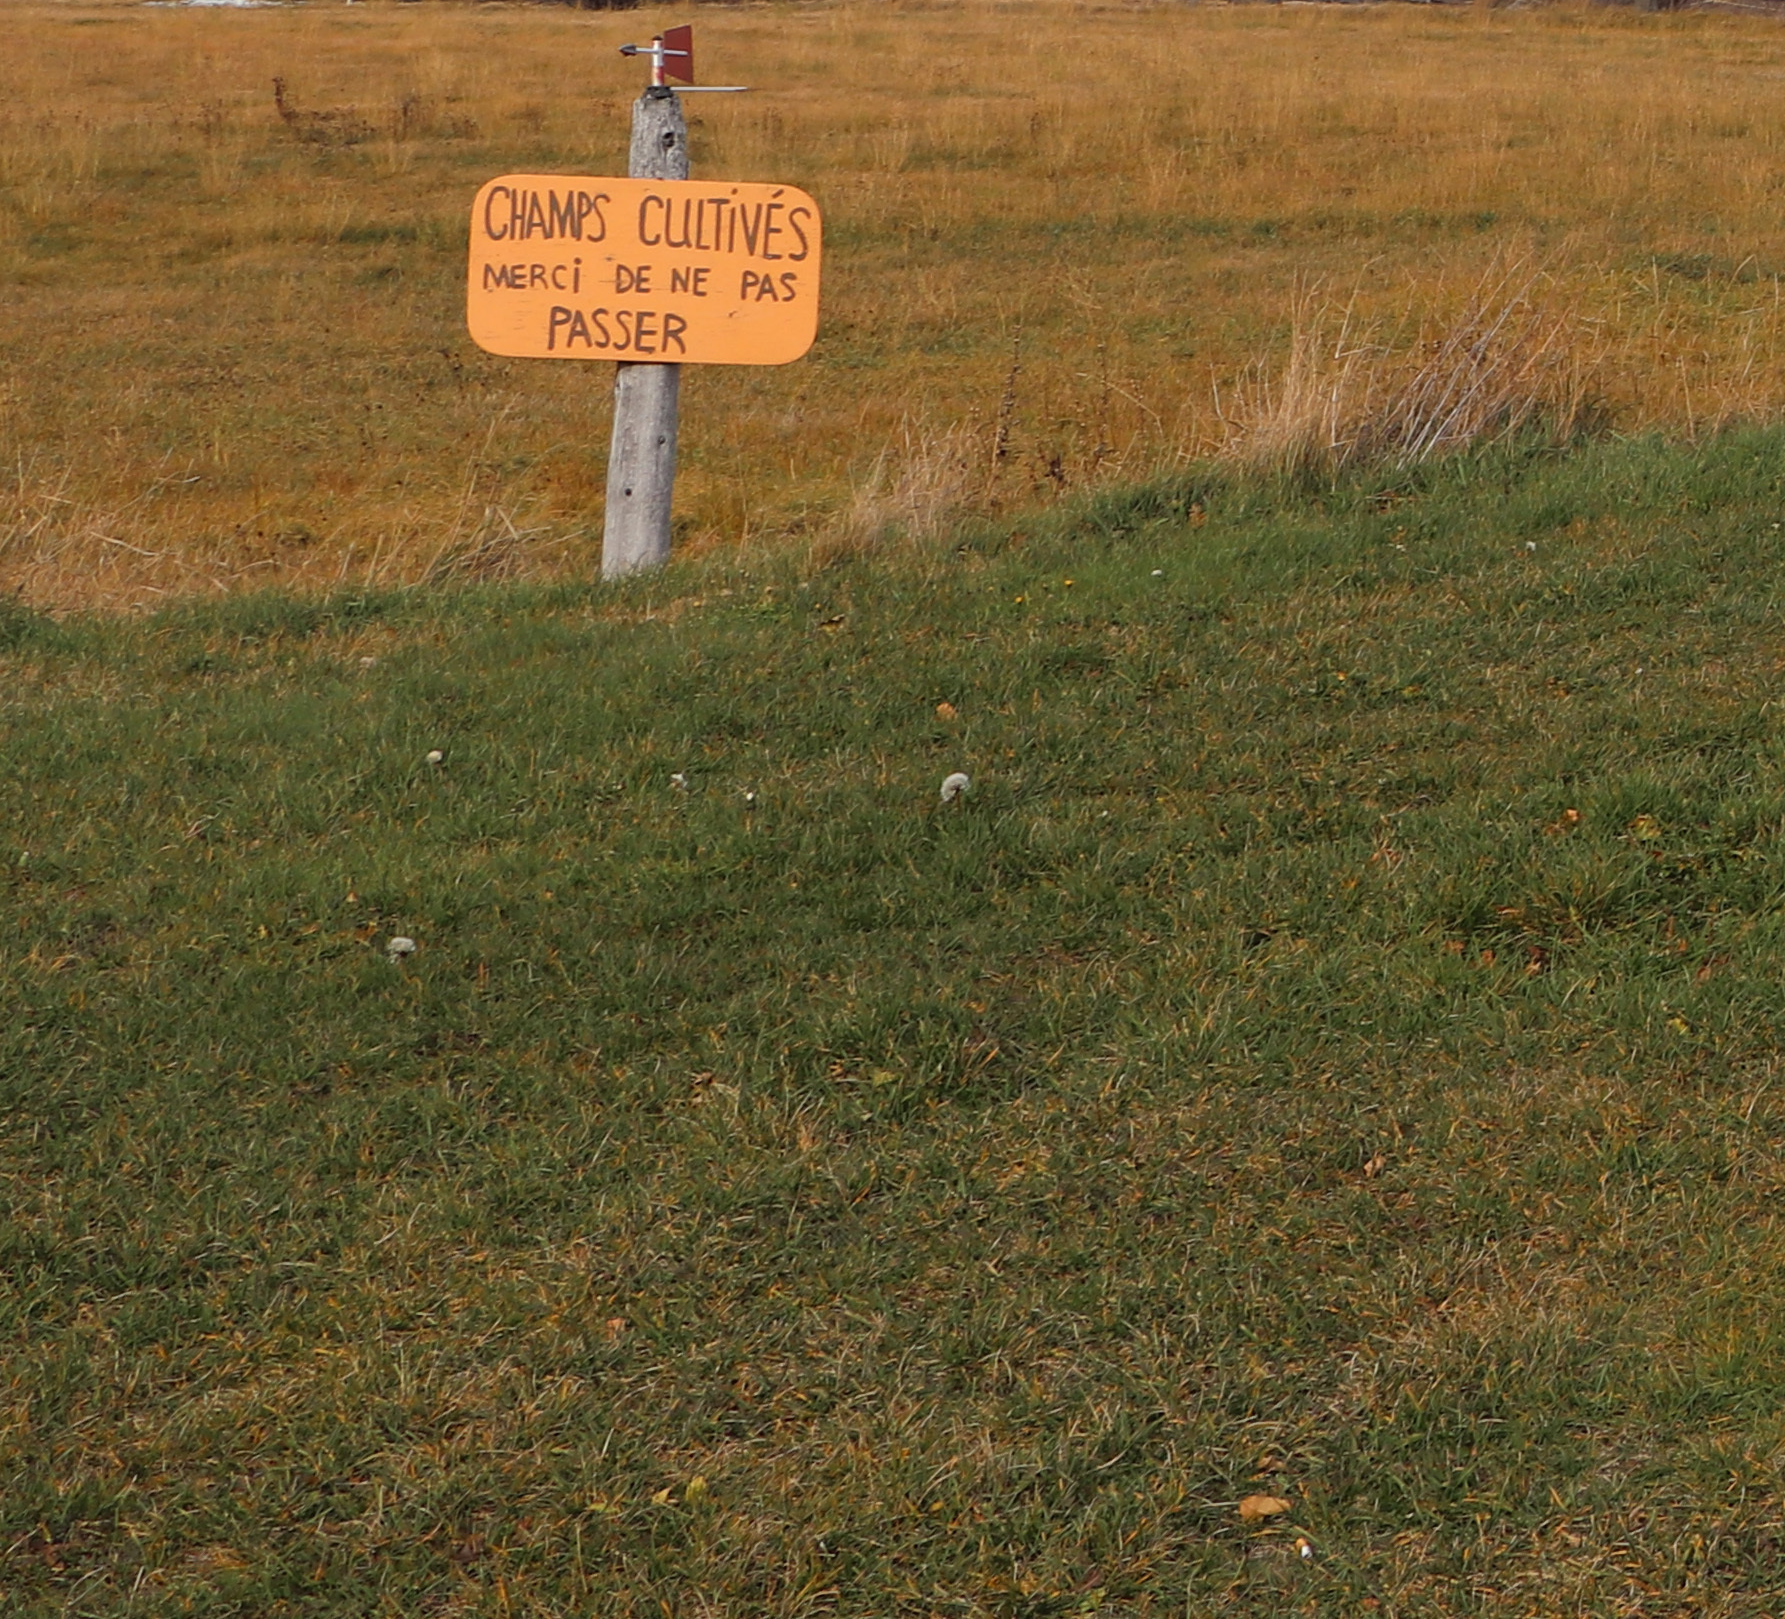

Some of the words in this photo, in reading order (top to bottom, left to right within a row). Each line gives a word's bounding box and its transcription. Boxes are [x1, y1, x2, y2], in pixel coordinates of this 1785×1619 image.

[484, 186, 611, 242] CHAMPS
[616, 264, 651, 293] DE
[671, 267, 711, 296] NE
[741, 270, 797, 302] PAS
[547, 306, 687, 354] PASSER
